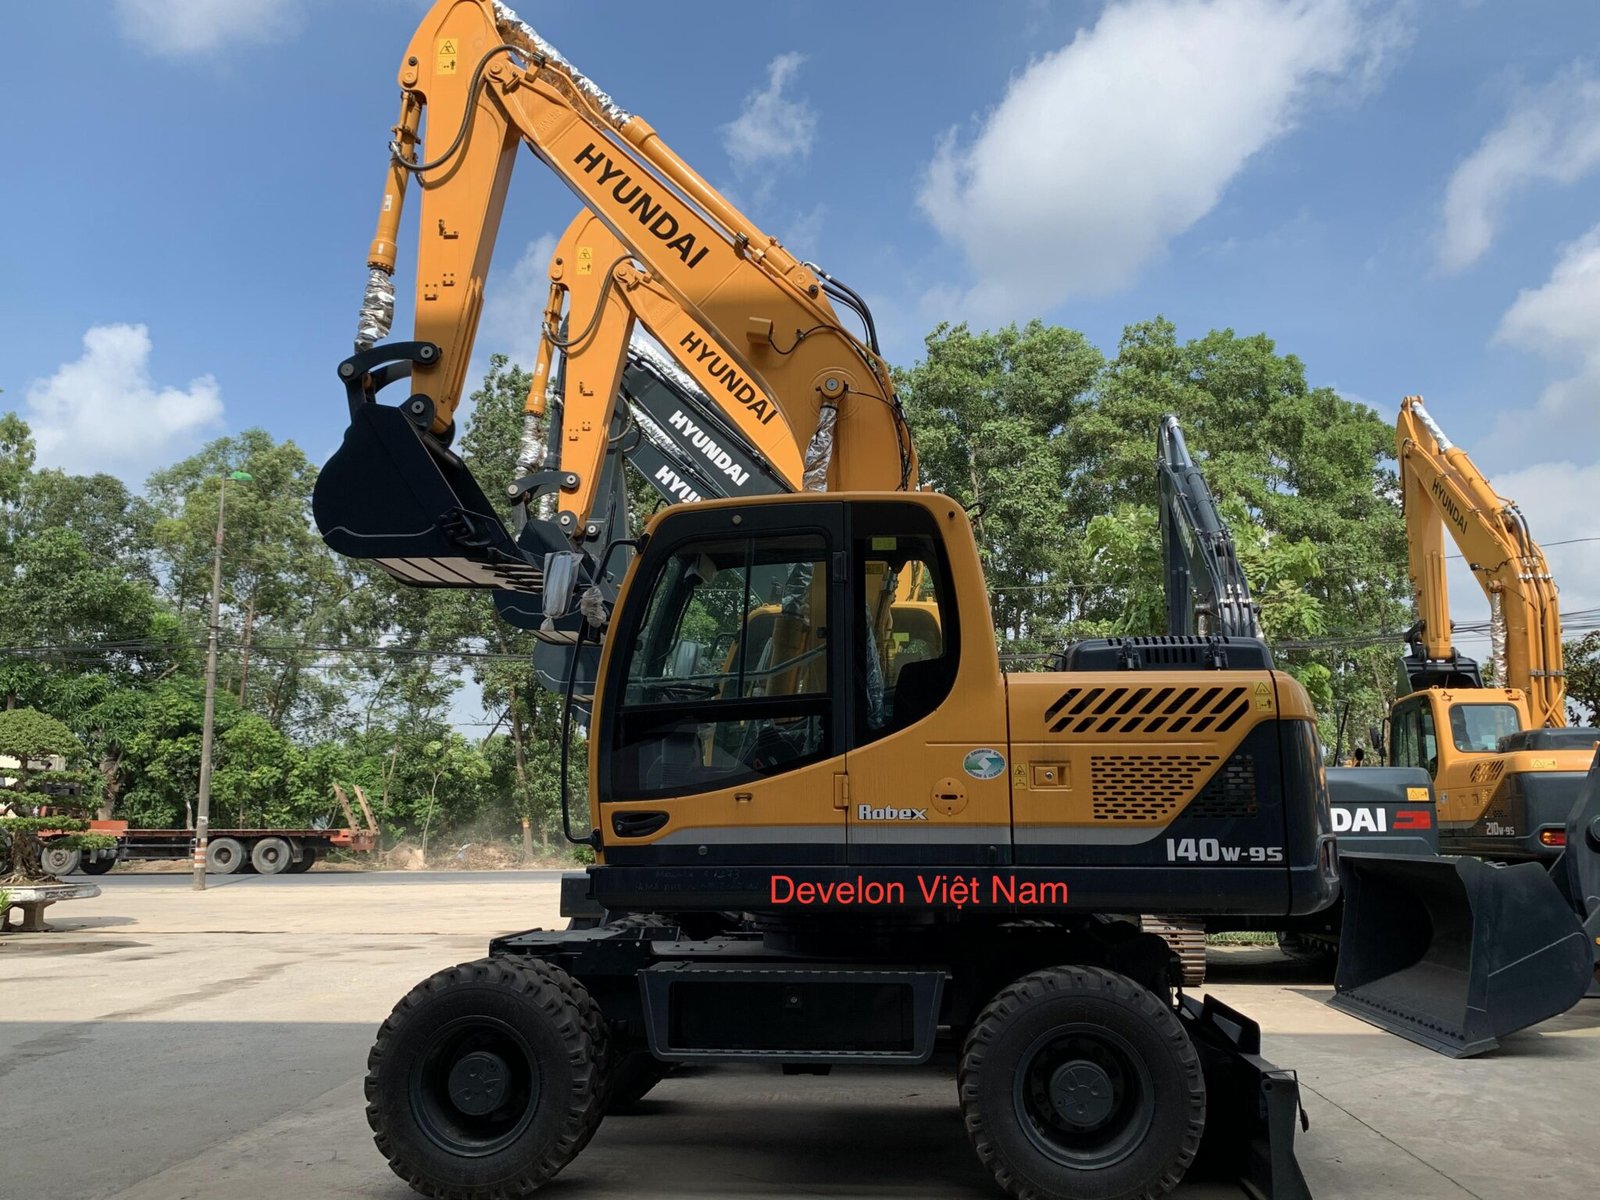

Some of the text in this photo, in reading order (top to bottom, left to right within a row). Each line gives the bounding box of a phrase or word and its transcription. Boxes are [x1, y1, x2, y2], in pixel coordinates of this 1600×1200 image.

[573, 143, 709, 269] HYUNDAI
[680, 330, 778, 425] HYUNDAI
[668, 410, 750, 487] HYUNDAI
[1432, 478, 1468, 535] HYUNDAI
